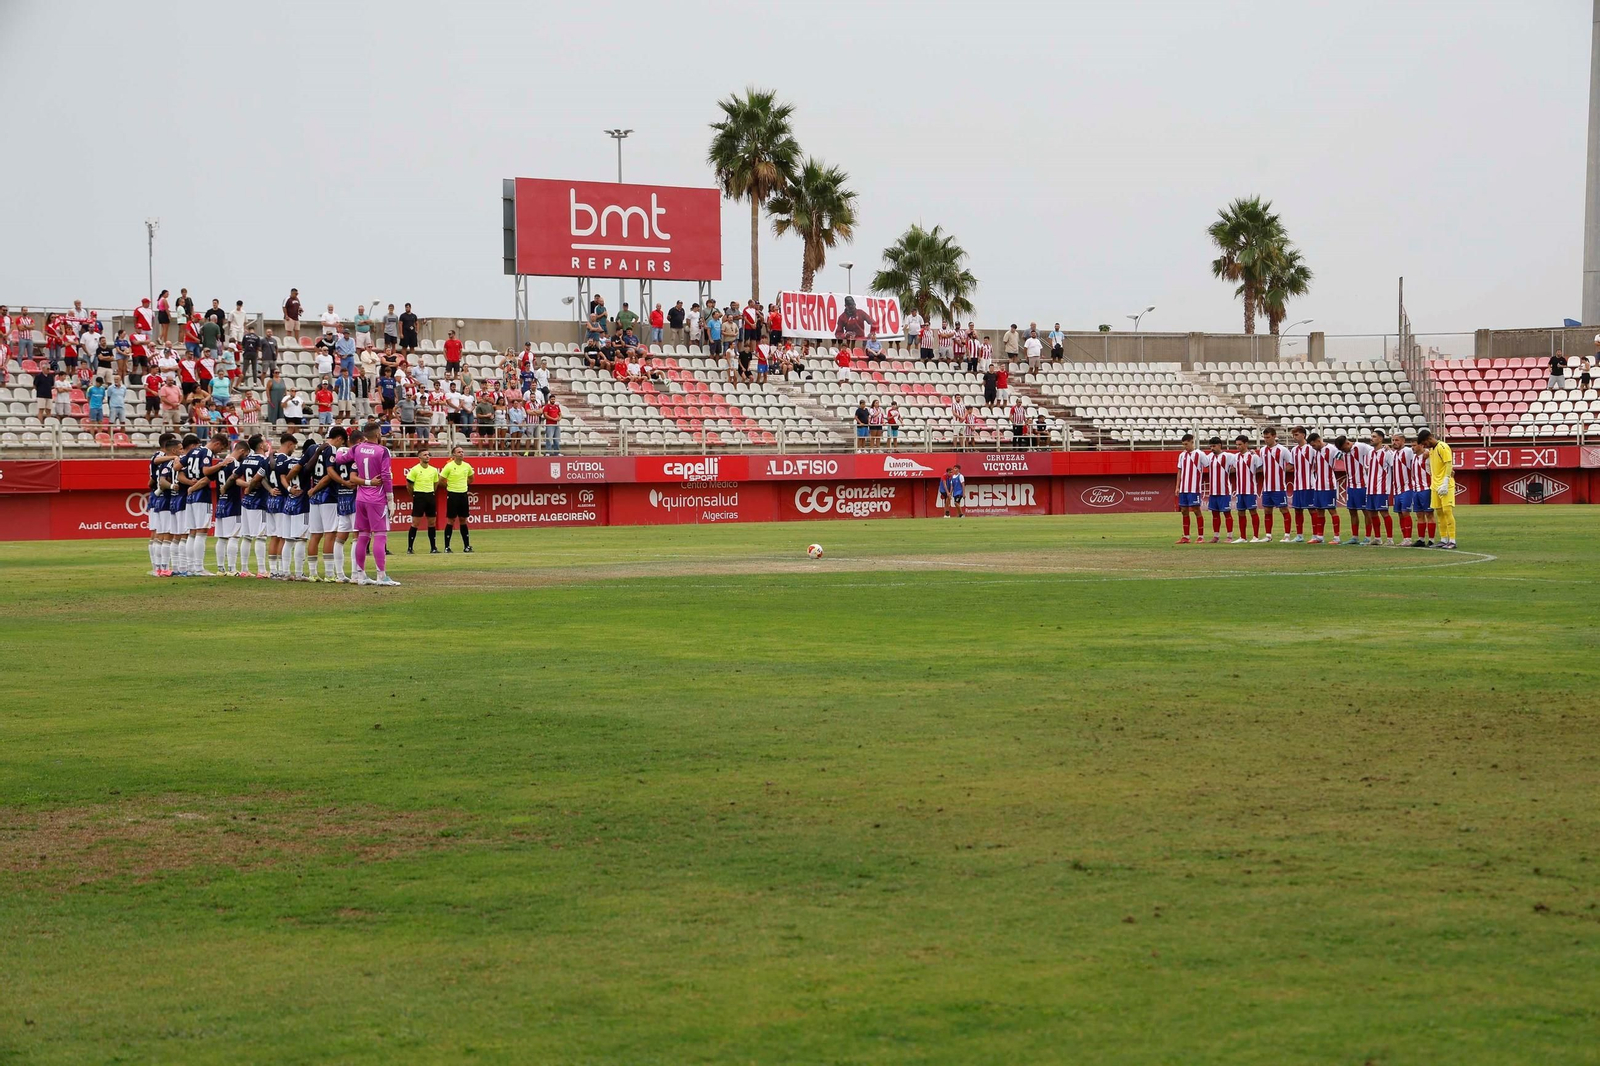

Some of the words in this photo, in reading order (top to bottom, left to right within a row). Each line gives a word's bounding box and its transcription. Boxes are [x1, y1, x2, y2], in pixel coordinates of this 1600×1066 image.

[570, 188, 671, 240] bmt
[571, 257, 671, 272] REPAIRS
[782, 292, 838, 332] ETERNO
[1474, 450, 1511, 467] EXO
[1521, 448, 1557, 467] EXO
[187, 457, 201, 479] 24
[363, 457, 370, 480] 1
[477, 467, 505, 475] LUMAR
[566, 460, 605, 472] FÚTBOL
[663, 457, 719, 480] capelli
[983, 462, 1029, 471] VICTORIA
[566, 472, 605, 480] COALITION
[835, 483, 896, 499] González
[1089, 488, 1115, 503] Ford
[492, 490, 567, 511] populares
[794, 485, 834, 514] GG
[702, 511, 739, 521] Algeciras
[835, 499, 892, 517] Gaggero
[483, 515, 494, 523] EL
[496, 513, 537, 522] DEPORTE
[539, 510, 596, 521] ALGECIREÑO
[78, 521, 102, 530] Audi
[104, 521, 139, 530] Center
